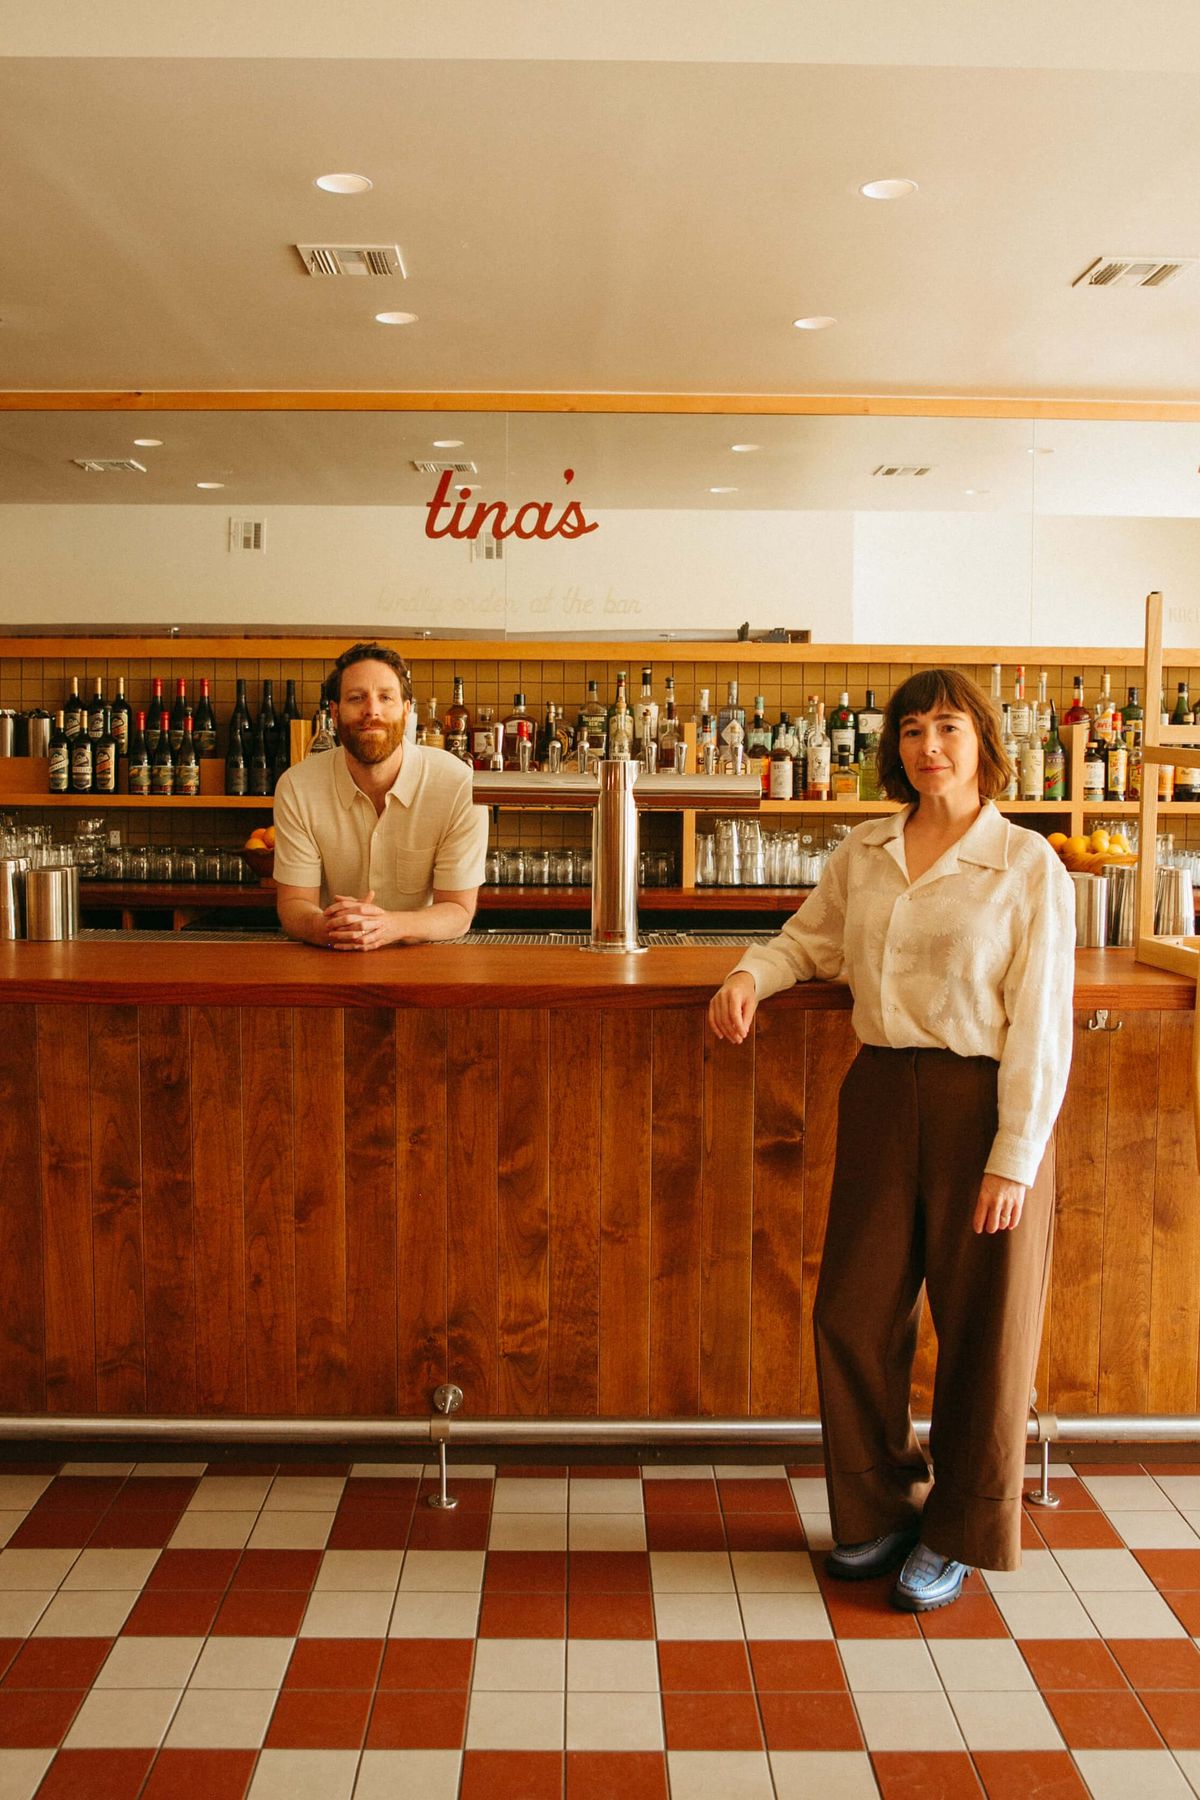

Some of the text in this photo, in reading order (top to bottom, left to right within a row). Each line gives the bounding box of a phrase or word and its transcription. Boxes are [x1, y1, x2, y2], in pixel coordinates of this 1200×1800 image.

[425, 469, 599, 540] tina's
[530, 587, 555, 613] at
[563, 587, 594, 613] the
[604, 587, 642, 613] bar
